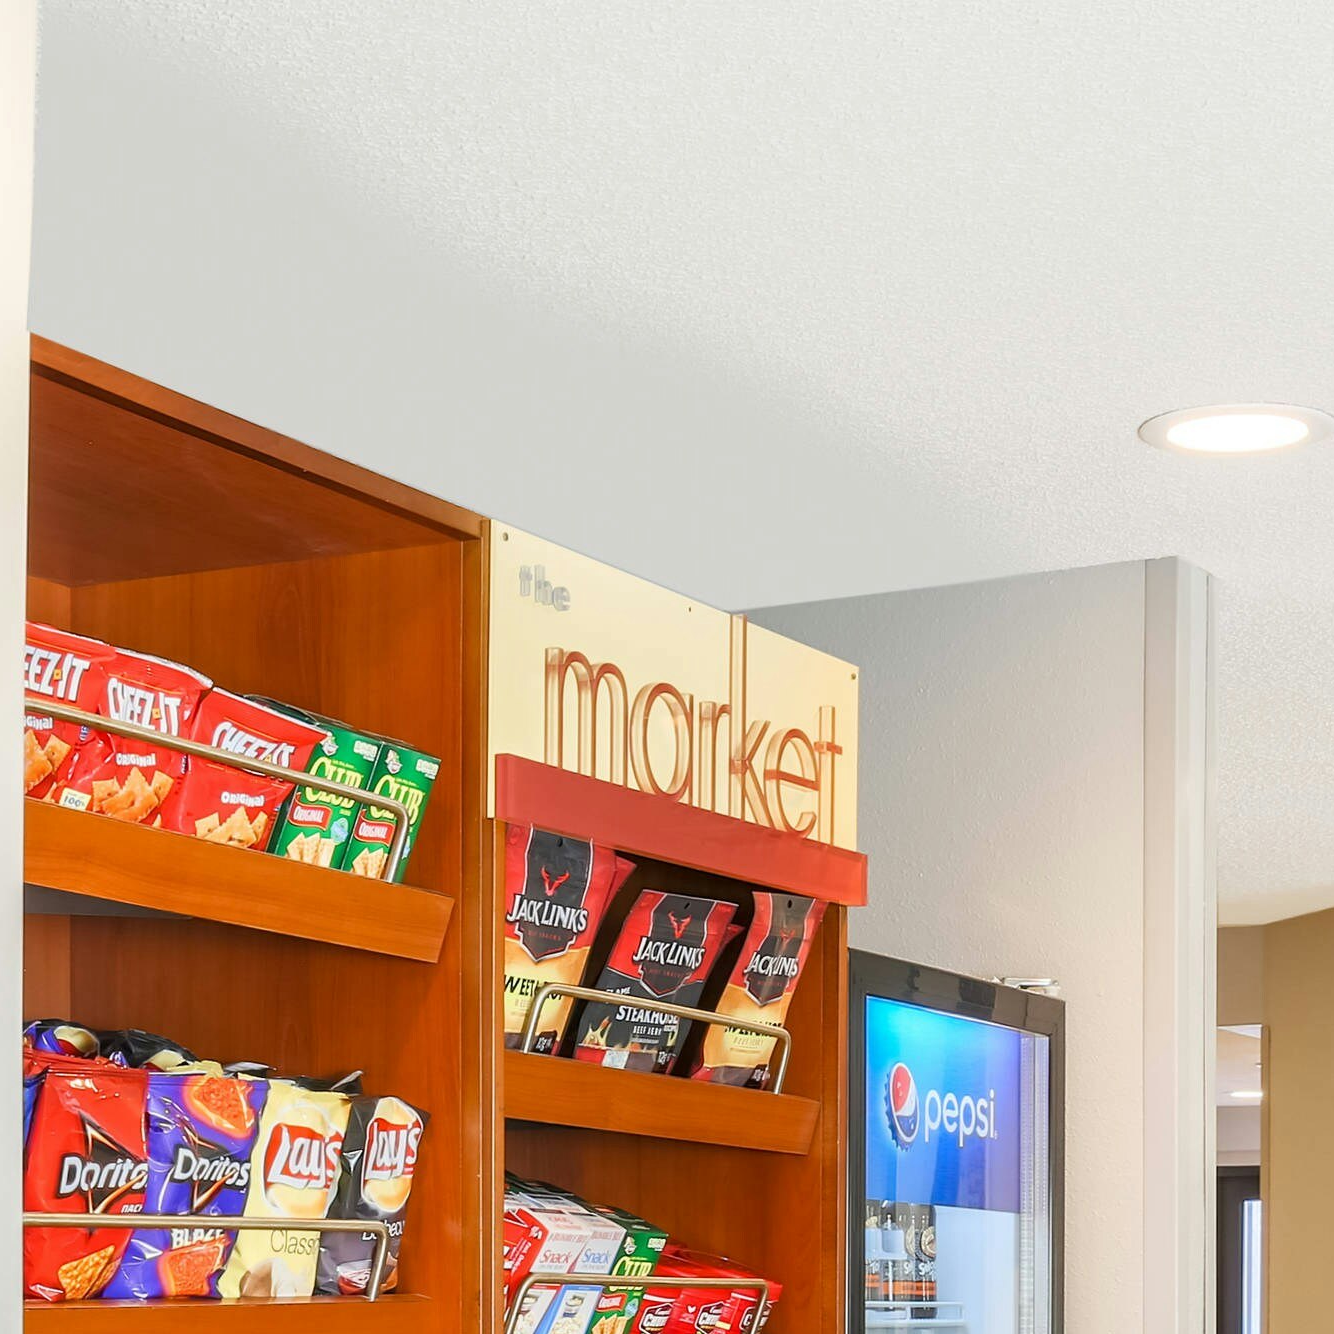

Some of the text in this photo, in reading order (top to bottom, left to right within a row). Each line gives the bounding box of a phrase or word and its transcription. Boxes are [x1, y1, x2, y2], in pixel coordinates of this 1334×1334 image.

[519, 563, 571, 612] the
[544, 613, 844, 847] market
[506, 894, 543, 927] JACK
[632, 936, 667, 966] JACK
[923, 1088, 996, 1148] pepsi
[59, 1155, 148, 1195] Dorito
[172, 1146, 252, 1188] Doritos
[267, 1124, 344, 1190] Lay's
[364, 1121, 421, 1180] Lay's
